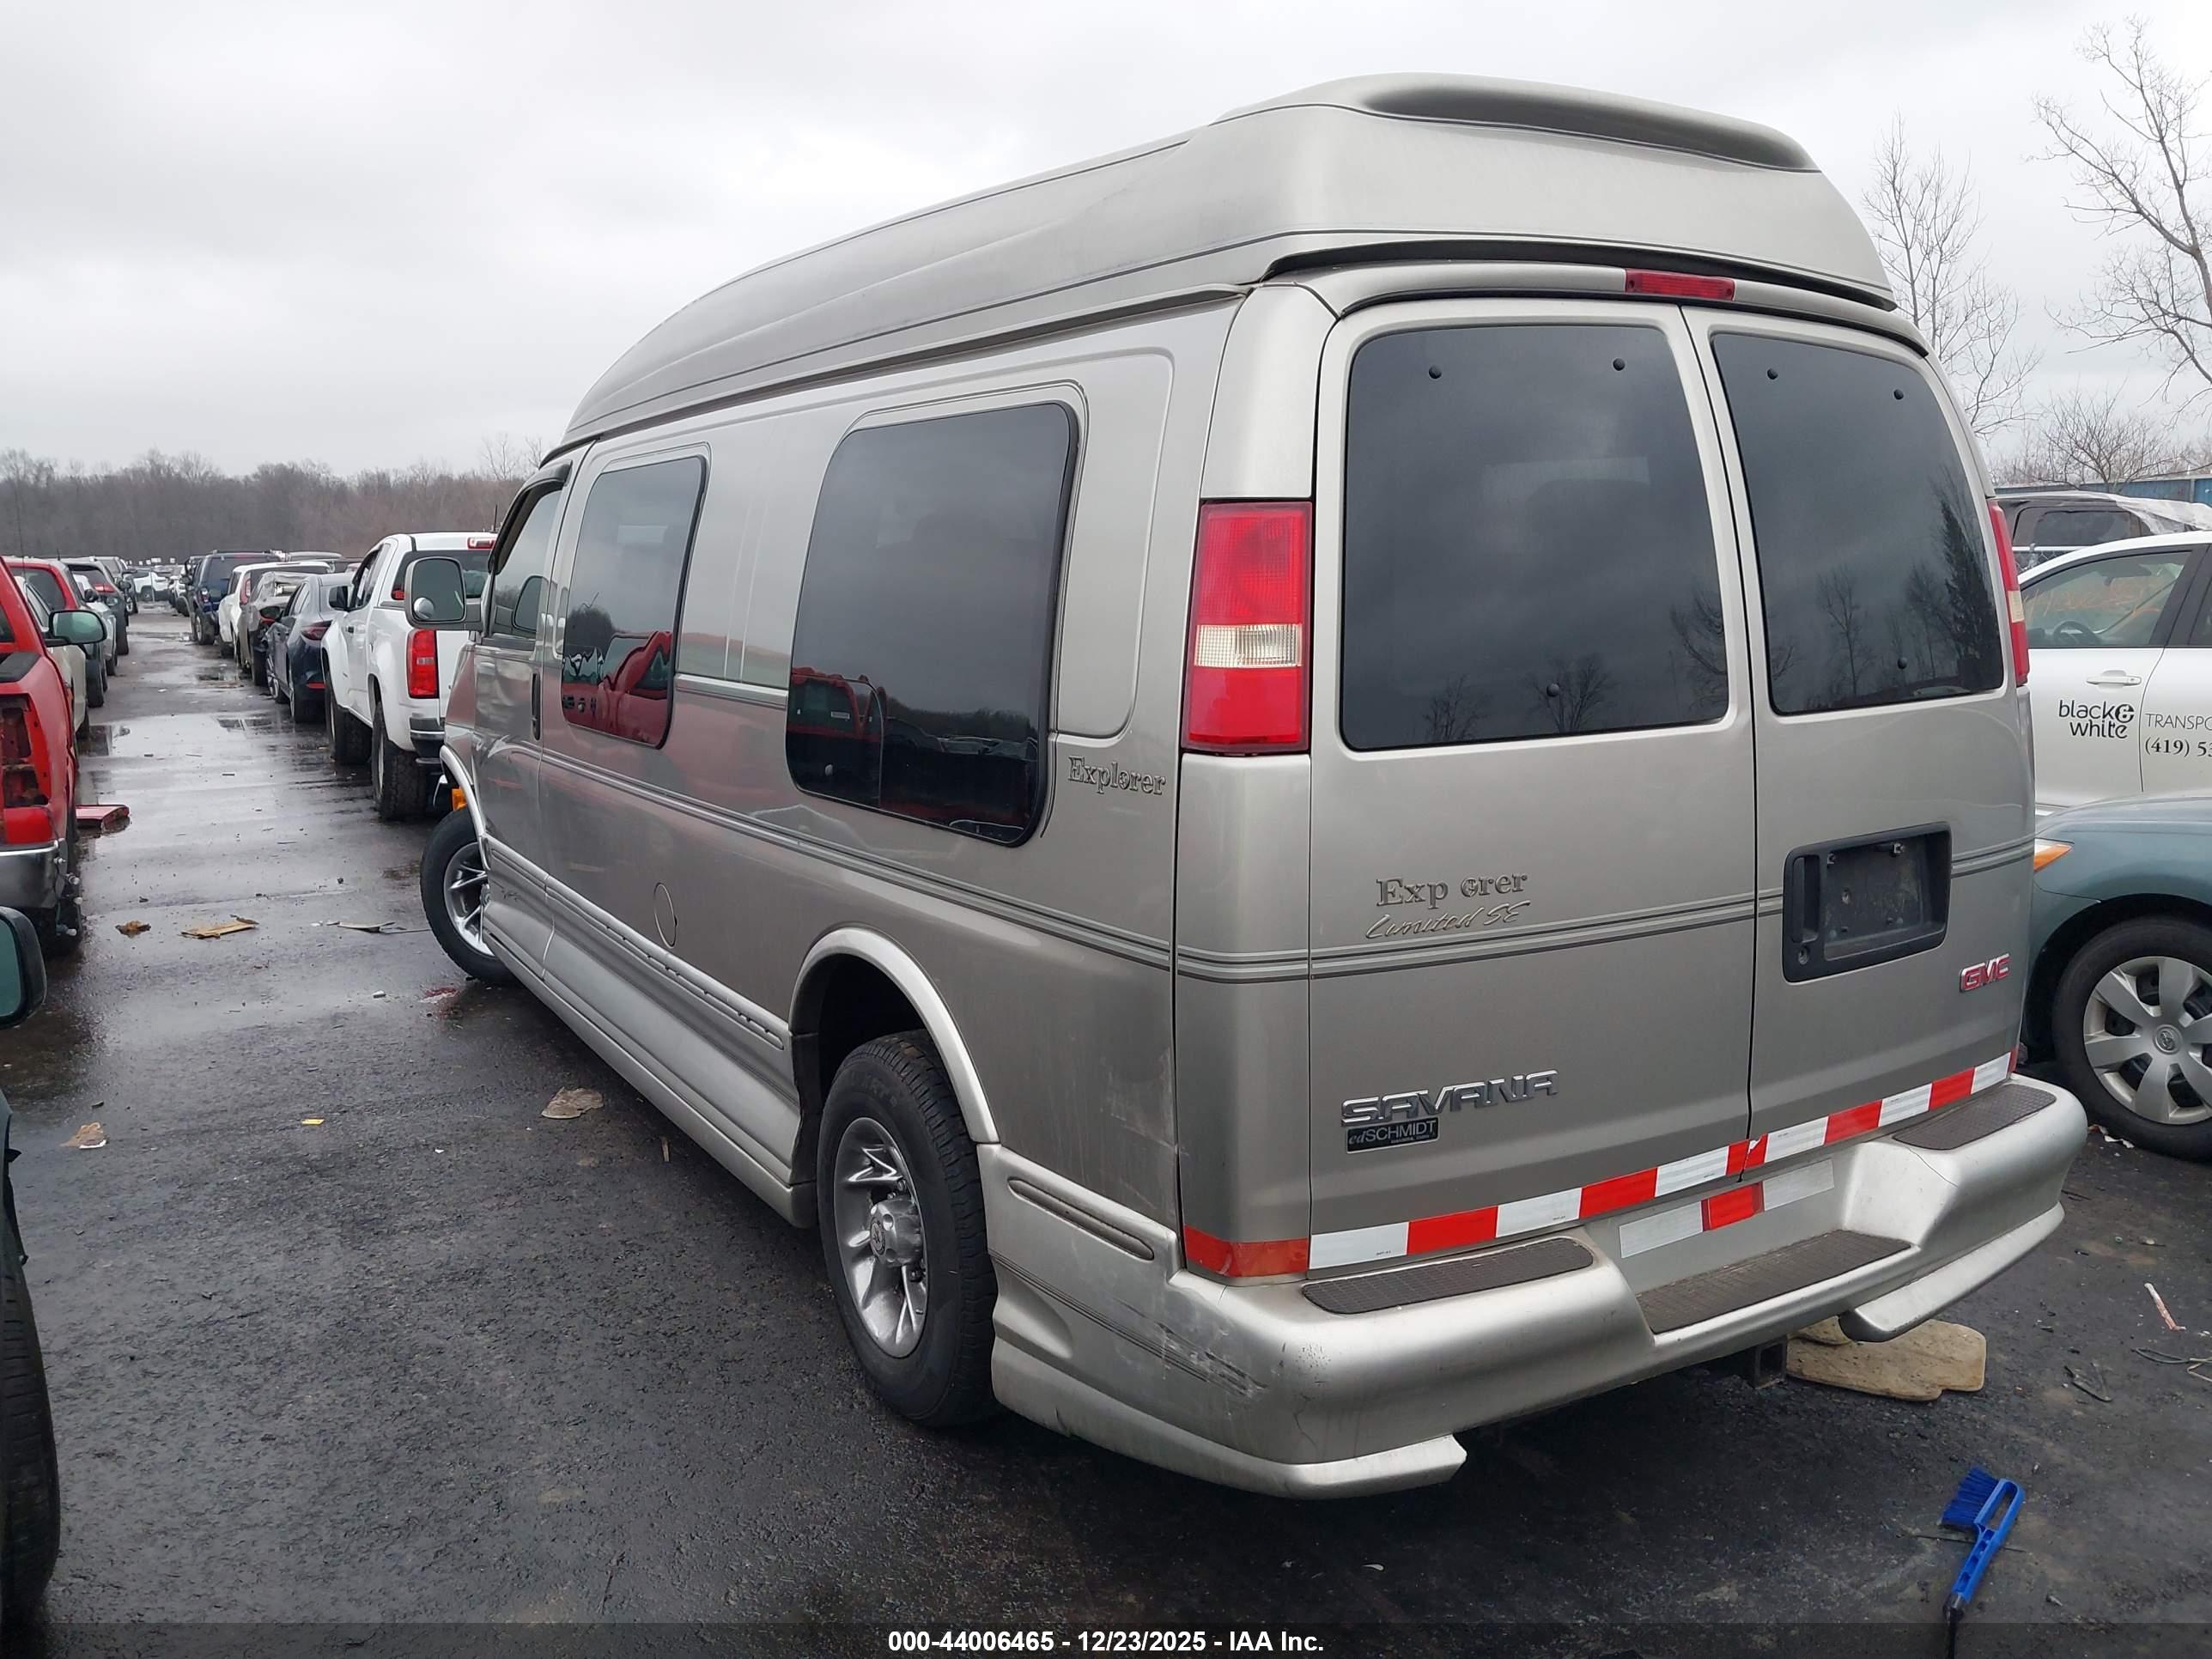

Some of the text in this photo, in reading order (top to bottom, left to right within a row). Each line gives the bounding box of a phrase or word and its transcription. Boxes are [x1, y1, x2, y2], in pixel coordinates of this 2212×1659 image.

[2069, 720, 2128, 739] white
[2145, 737, 2191, 757] (419)
[1067, 755, 1166, 795] Explorer
[1365, 900, 1532, 939] Limited SE
[1960, 952, 2011, 993] GMC
[1340, 1068, 1559, 1127] SAVANA
